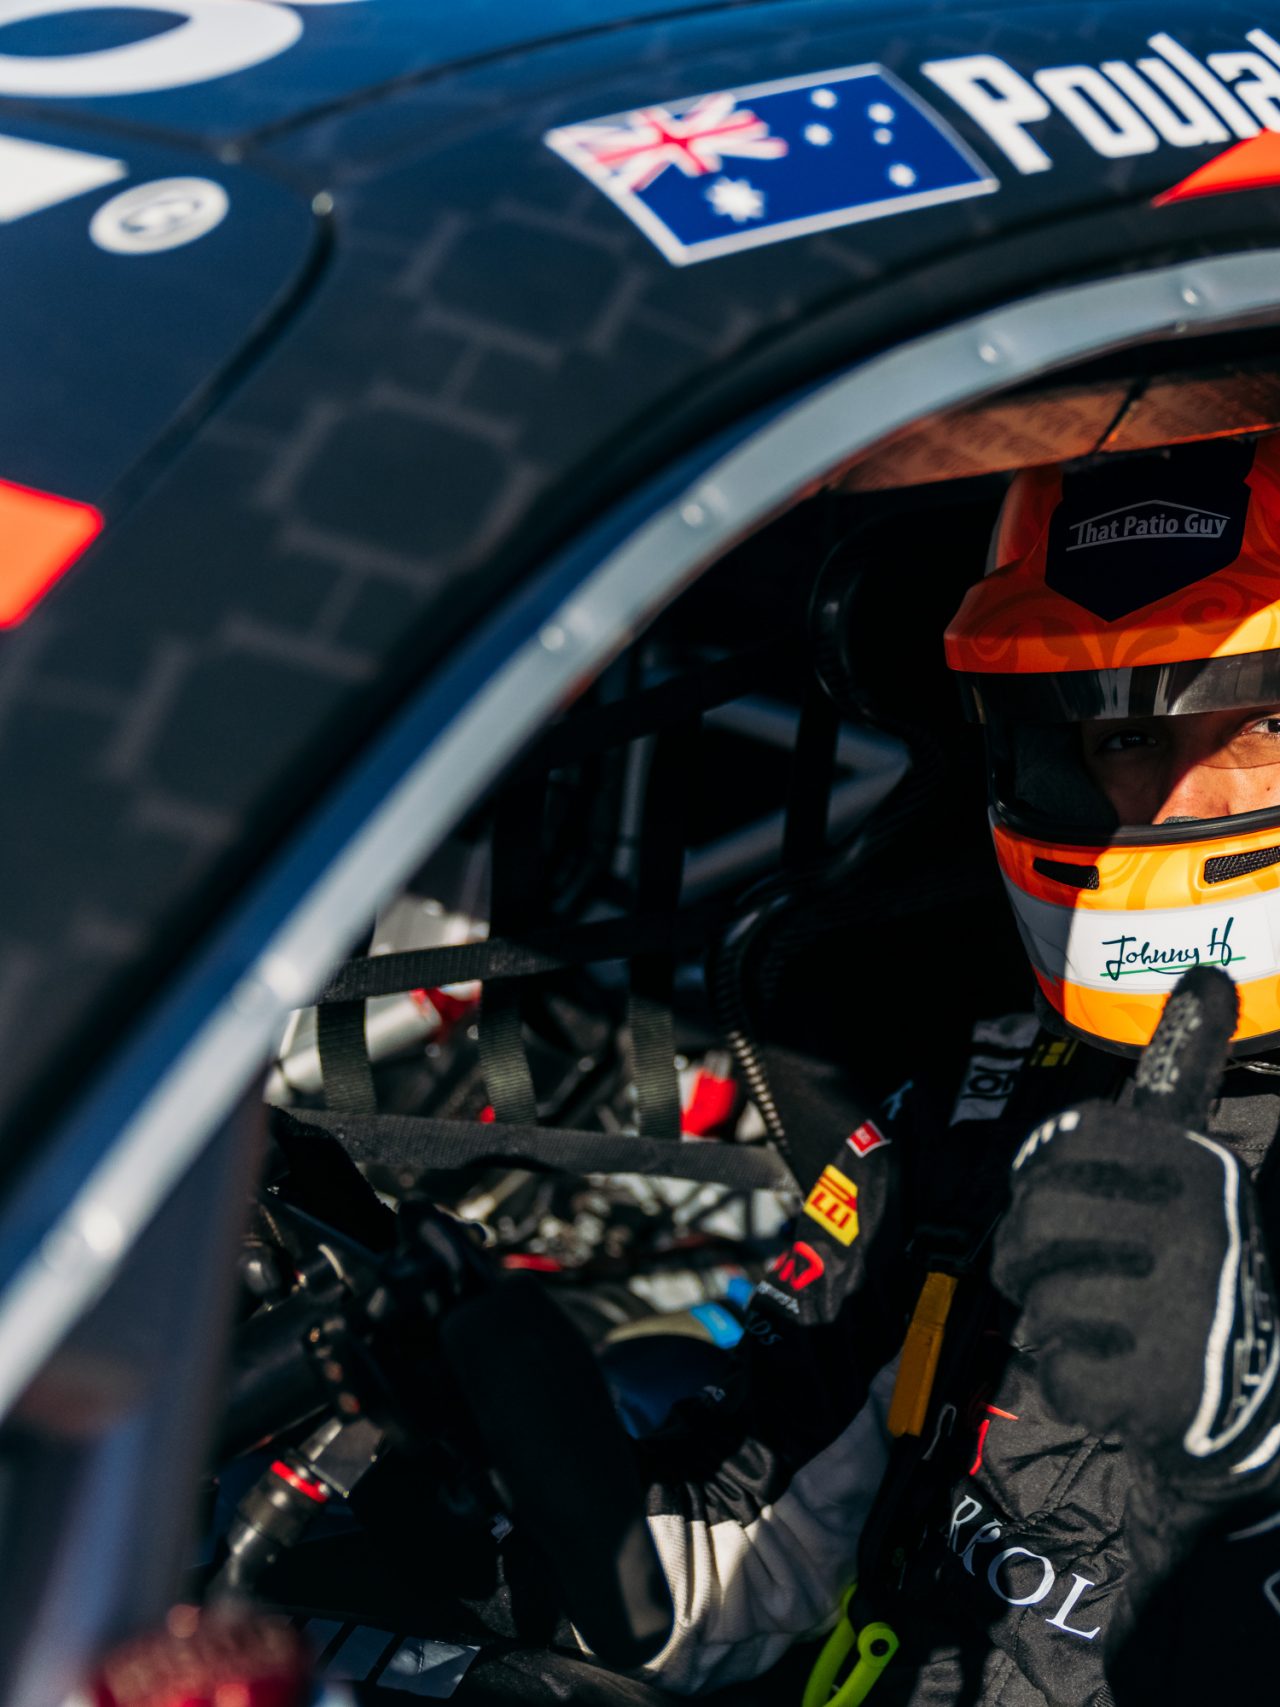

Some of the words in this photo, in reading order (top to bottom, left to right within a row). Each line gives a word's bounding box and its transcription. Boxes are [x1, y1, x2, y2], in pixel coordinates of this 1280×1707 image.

[1074, 518, 1117, 545] That
[1123, 513, 1183, 537] Patio
[1185, 513, 1228, 538] Guy
[1101, 934, 1199, 981] Johnny
